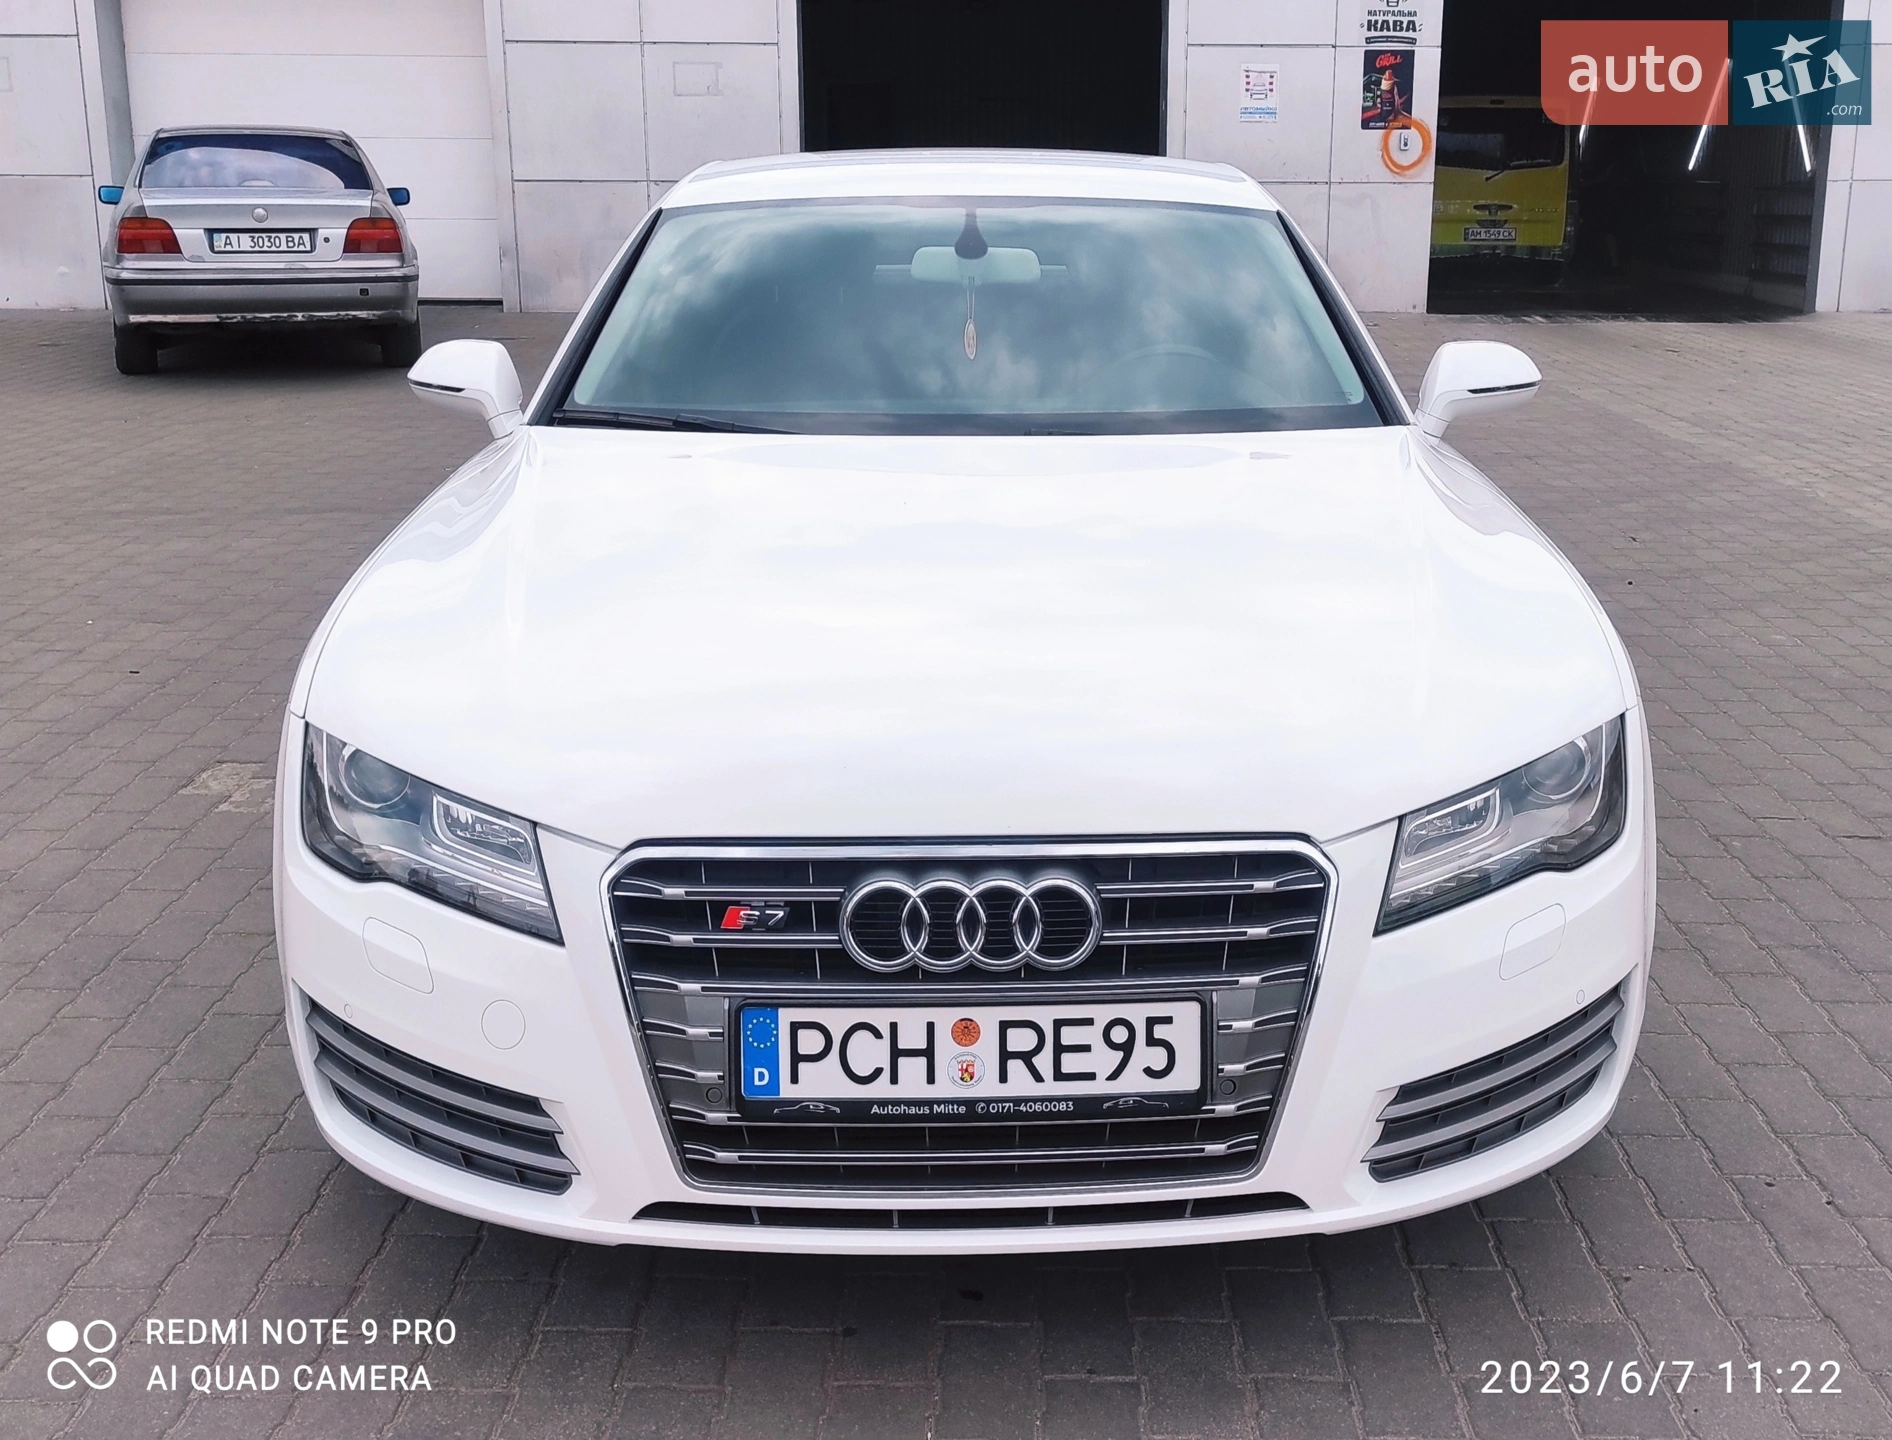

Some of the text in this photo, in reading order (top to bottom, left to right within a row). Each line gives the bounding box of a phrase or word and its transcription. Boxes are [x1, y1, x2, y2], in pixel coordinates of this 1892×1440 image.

[1367, 9, 1418, 18] НАТУРАЛЬНА
[1366, 19, 1417, 33] КАВА
[1470, 229, 1482, 238] AM
[1502, 229, 1514, 238] CK
[223, 234, 307, 249] AI 3030 BA
[737, 910, 785, 926] S7
[789, 1015, 1177, 1085] PCH RE95
[753, 1066, 770, 1086] D
[870, 1101, 1074, 1115] Autohaus Mitte 0171-4060083
